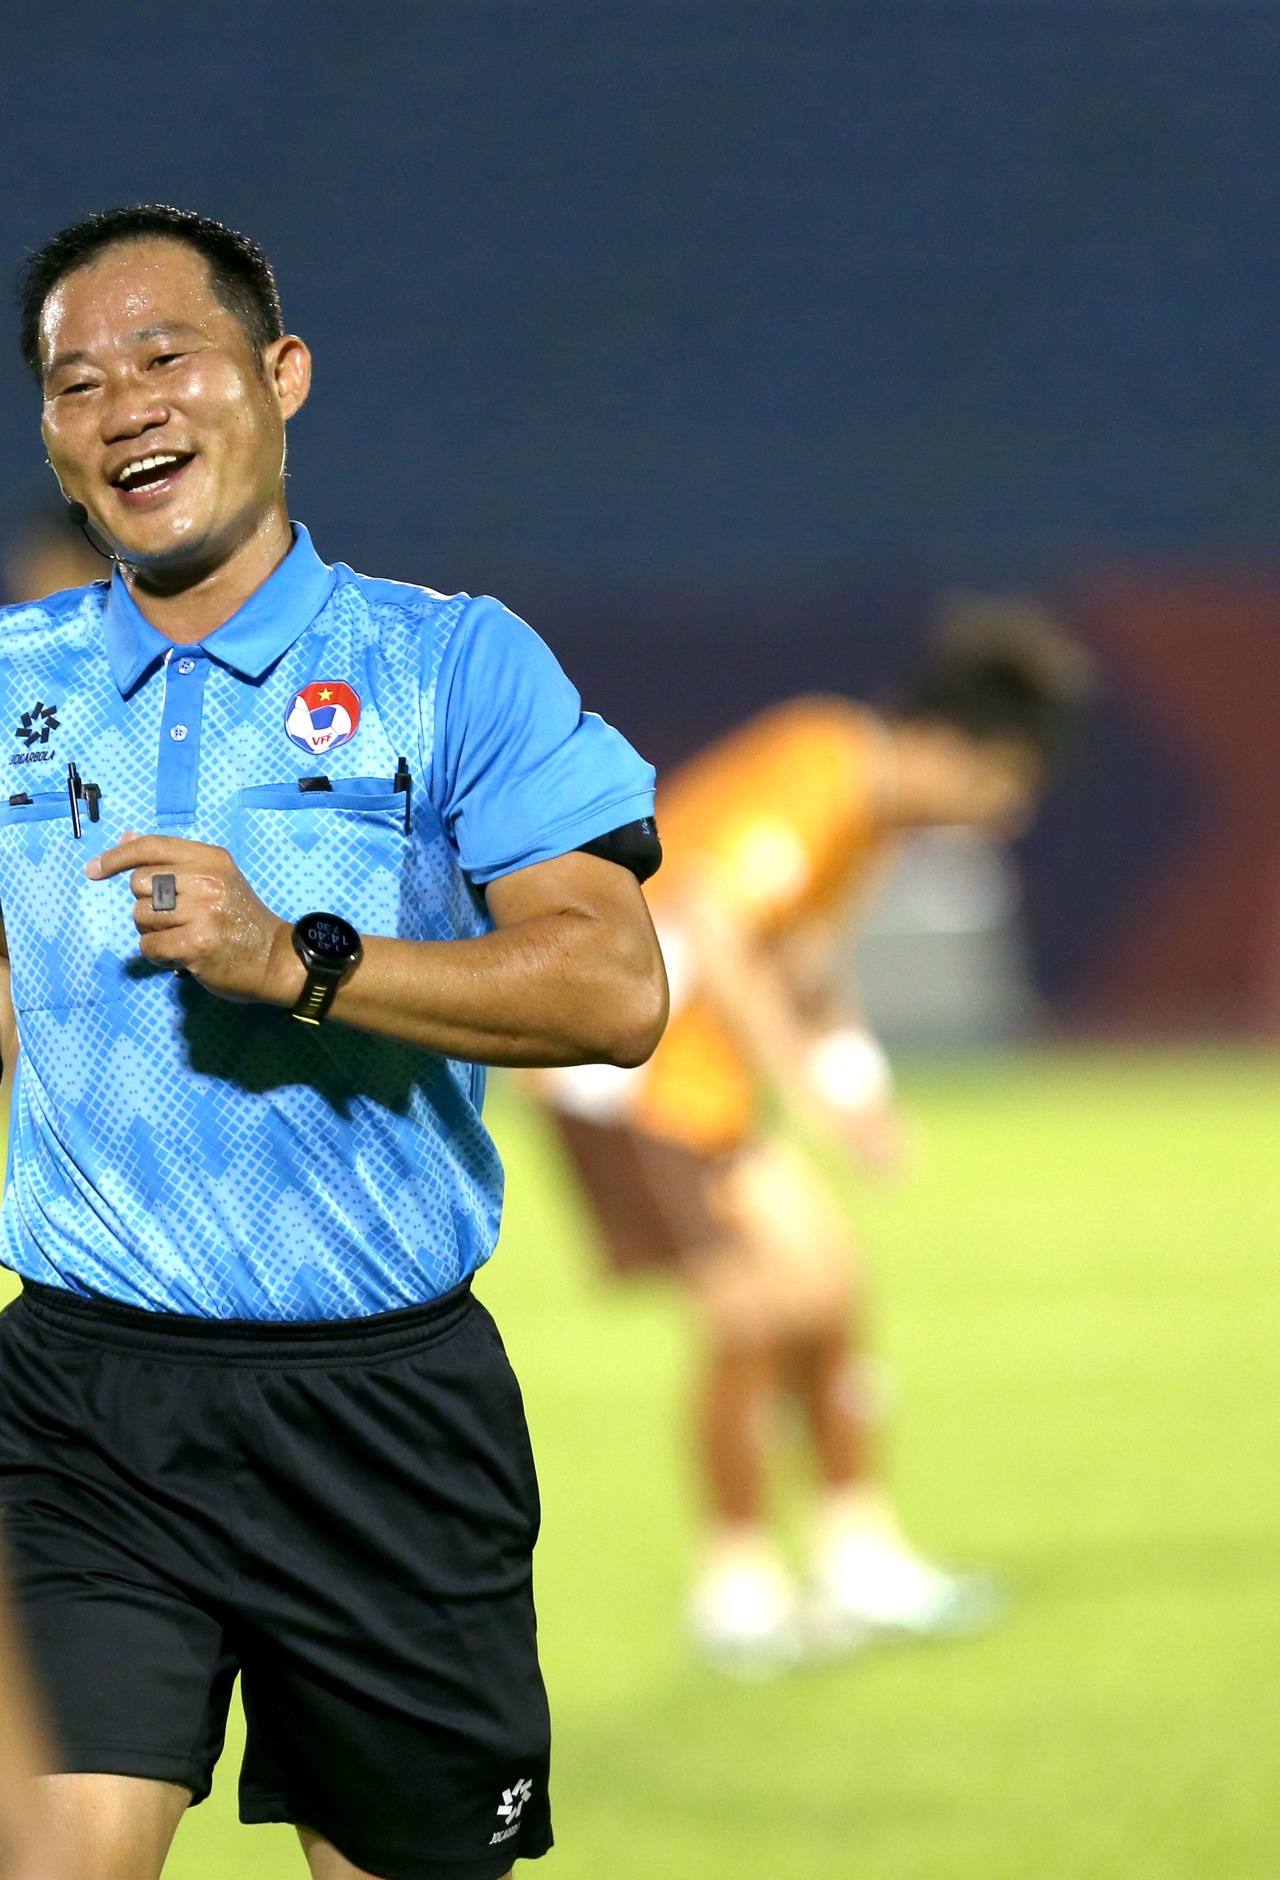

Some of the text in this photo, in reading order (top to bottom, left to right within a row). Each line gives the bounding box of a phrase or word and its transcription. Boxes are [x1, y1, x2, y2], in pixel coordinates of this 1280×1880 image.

[312, 733, 332, 745] VFF
[8, 750, 55, 765] JOGARBOLA
[308, 928, 349, 946] 14:40
